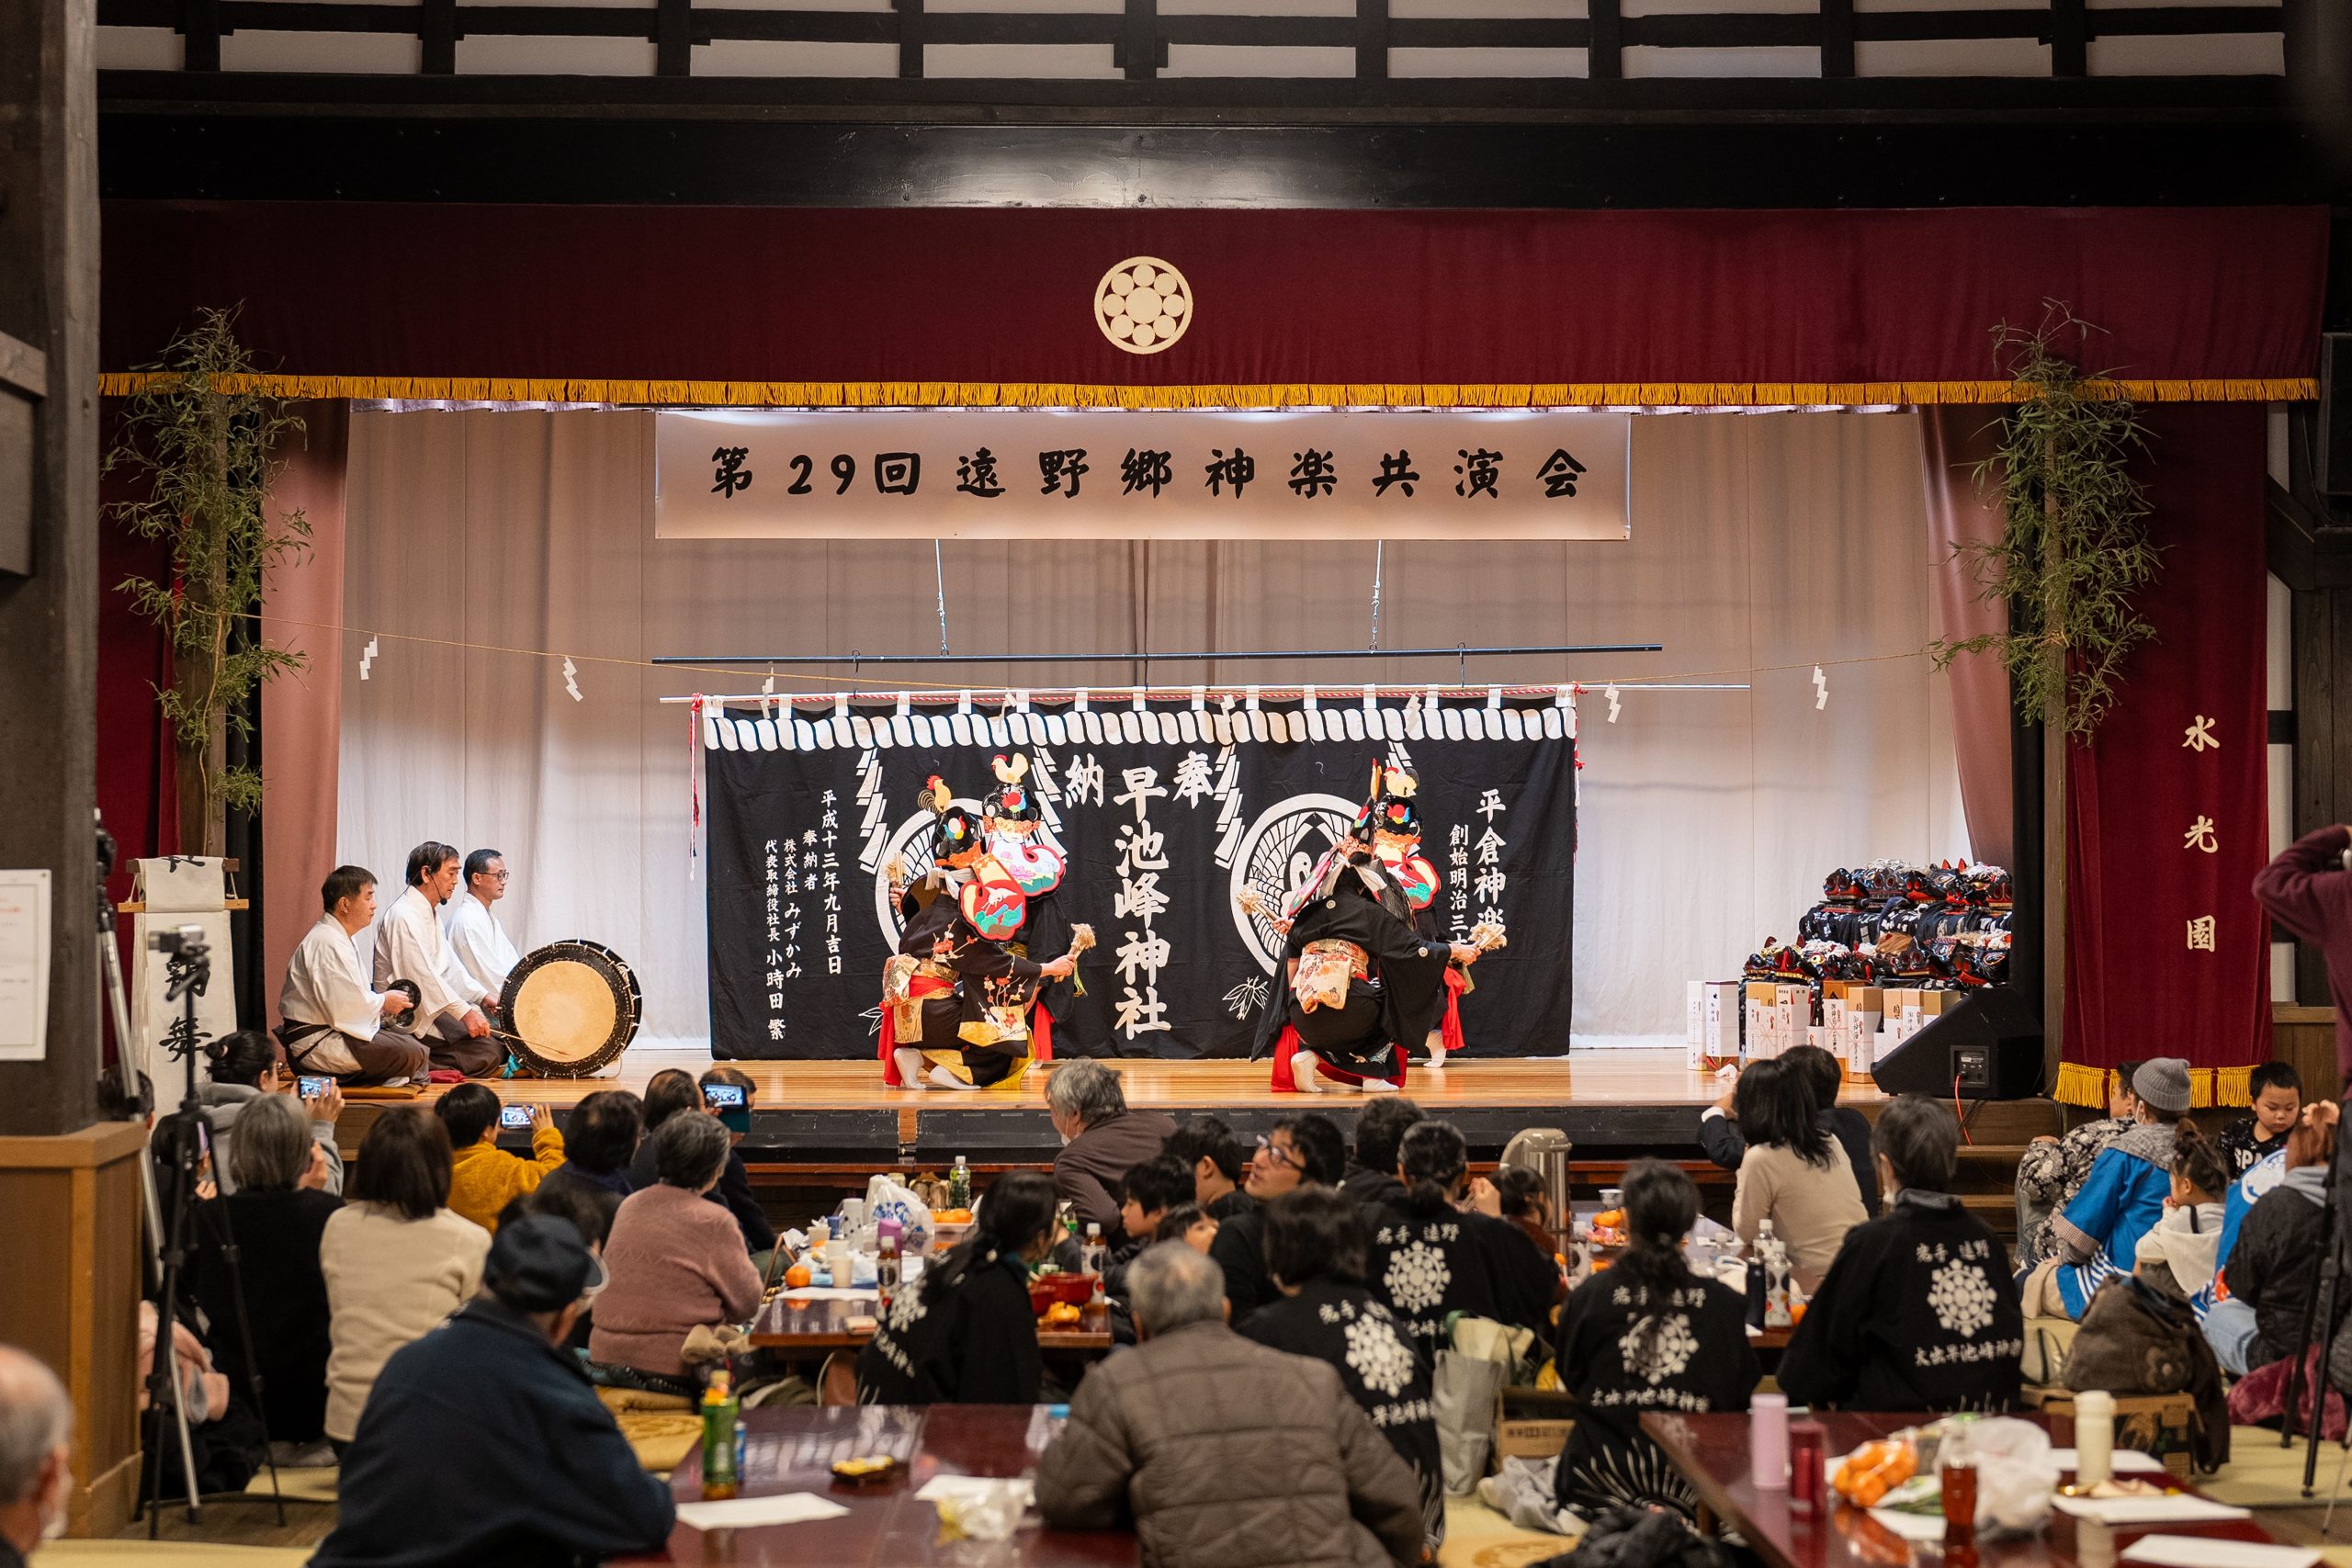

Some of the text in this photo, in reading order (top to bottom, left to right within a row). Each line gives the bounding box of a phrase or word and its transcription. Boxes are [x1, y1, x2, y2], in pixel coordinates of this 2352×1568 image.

[710, 446, 1588, 500] 第29回遠野郷神楽共演会
[802, 829, 819, 891] 奉納者
[820, 789, 842, 975] 平成十三年九月吉日
[1113, 765, 1172, 1041] 早池峰神社
[2181, 714, 2221, 953] 水光園
